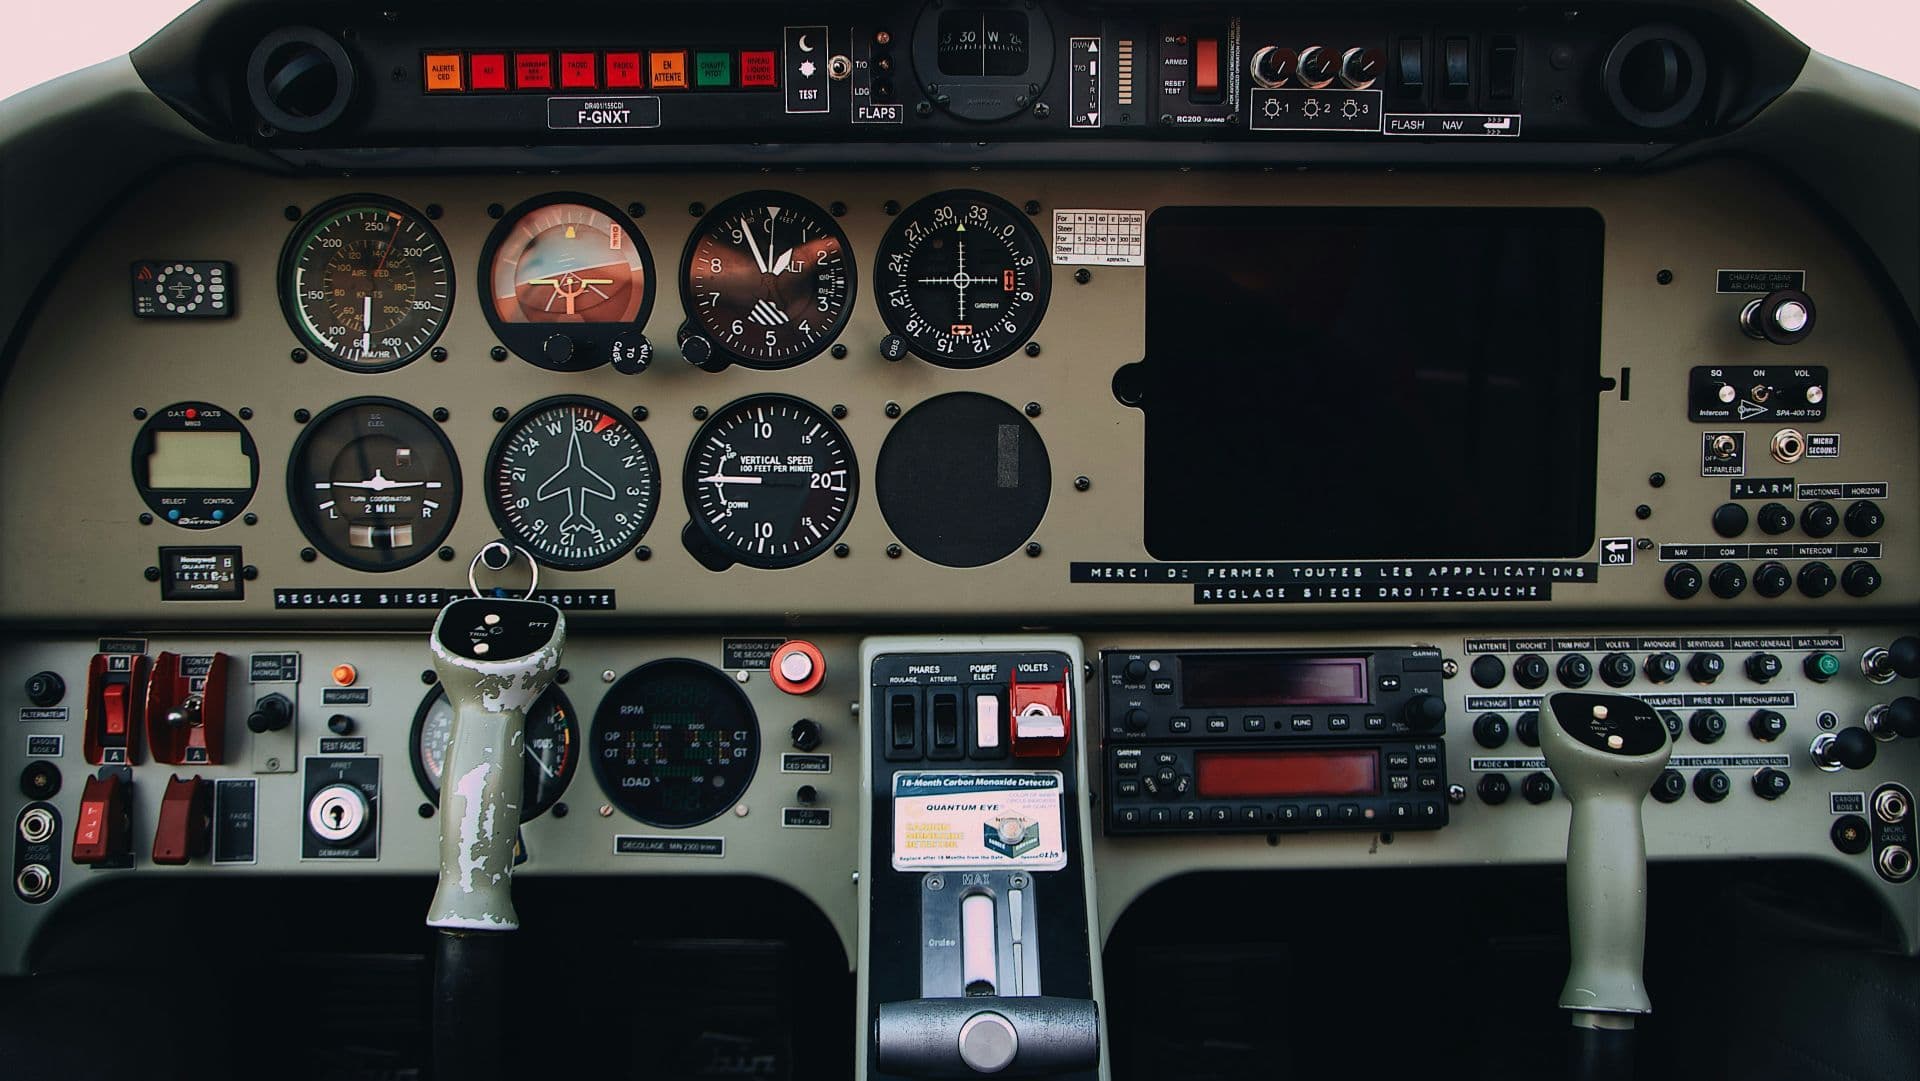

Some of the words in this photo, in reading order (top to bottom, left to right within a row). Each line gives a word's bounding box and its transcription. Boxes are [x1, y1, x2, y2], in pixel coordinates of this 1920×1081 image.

[959, 31, 976, 43] 30
[988, 31, 999, 43] W
[432, 65, 456, 73] ALERTE
[663, 61, 672, 71] EN
[856, 60, 868, 69] T/O
[1074, 64, 1087, 73] T/O
[437, 73, 451, 81] CED
[654, 72, 682, 82] ATTENTE
[1164, 80, 1186, 88] RESET
[799, 90, 818, 100] TEST
[855, 87, 870, 97] LDG
[859, 107, 896, 120] FLAPS
[1324, 104, 1332, 114] 2
[1362, 104, 1370, 114] 3
[578, 111, 631, 125] F-GNXT
[1076, 115, 1087, 123] UP
[1391, 120, 1425, 131] FLASH
[1442, 120, 1464, 131] NAV
[934, 205, 954, 222] 30
[968, 205, 988, 221] 33
[365, 222, 384, 232] 250
[904, 221, 923, 242] 27
[731, 229, 744, 244] 9
[323, 239, 342, 248] 200
[403, 248, 423, 258] 300
[817, 251, 829, 266] 2
[711, 258, 723, 274] 8
[888, 254, 904, 273] 24
[308, 291, 325, 300] 150
[709, 292, 721, 308] 7
[413, 301, 432, 310] 350
[817, 296, 829, 312] 3
[329, 326, 346, 336] 100
[732, 320, 744, 336] 6
[798, 320, 811, 336] 4
[382, 338, 402, 347] 400
[765, 331, 777, 347] 5
[889, 340, 901, 360] OBS
[1710, 369, 1723, 378] SQ
[1753, 369, 1765, 377] ON
[1794, 369, 1810, 377] VOL
[200, 410, 222, 418] VOLTS
[1699, 409, 1730, 417] Intercom
[545, 421, 562, 436] W
[575, 419, 593, 433] 30
[754, 422, 772, 439] 10
[602, 429, 621, 447] 33
[801, 435, 812, 444] 15
[1813, 437, 1834, 445] MICRO
[521, 437, 541, 456] 24
[1808, 446, 1837, 455] SECOURS
[740, 455, 781, 465] VERTICAL
[786, 455, 814, 465] SPEED
[740, 465, 753, 473] 100
[754, 465, 772, 473] FEET
[773, 465, 788, 473] PER
[789, 465, 814, 473] MINUTE
[810, 472, 832, 489] 20
[1801, 488, 1841, 496] DIRECTIONNEL
[1851, 487, 1881, 495] HORIZON
[365, 505, 372, 513] 2
[375, 504, 396, 513] MIN
[728, 501, 749, 509] DOWN
[801, 516, 812, 526] 15
[754, 522, 773, 539] 10
[1719, 548, 1736, 556] COM
[1765, 548, 1779, 556] ATC
[1799, 547, 1833, 555] INTERCOM
[1608, 554, 1625, 563] ON
[1091, 568, 1149, 578] MERCI
[1208, 568, 1275, 578] FERMER
[1292, 567, 1362, 577] TOUTES
[1380, 567, 1413, 577] LES
[1428, 566, 1584, 578] APPPLICATIONS
[1203, 588, 1285, 599] REGLAGE
[1303, 588, 1362, 598] SIEGE
[1379, 586, 1537, 598] DROITE-GAUCHE
[277, 594, 362, 604] REGLAGE
[380, 594, 439, 604] SIEGE
[1515, 642, 1547, 650] CROCHET
[1557, 641, 1574, 649] TRIM
[1605, 640, 1631, 648] VOLETS
[1643, 640, 1677, 648] AVIONIQUE
[1687, 640, 1725, 648] SERVITUDES
[1761, 640, 1792, 648] GENERALE
[1814, 639, 1840, 647] TAMPON
[114, 660, 126, 670] M
[969, 665, 997, 673] POMPE
[1018, 663, 1048, 673] VOLETS
[1664, 660, 1676, 670] 40
[1708, 659, 1720, 670] 40
[909, 665, 941, 674] PHARES
[890, 676, 917, 684] ROULAGE
[974, 673, 994, 681] ELECT
[33, 682, 40, 691] 5
[1155, 682, 1170, 690] MON
[1471, 699, 1507, 707] AFFICHAGE
[1739, 696, 1787, 704] PRECHAUFFAGE
[620, 705, 644, 715] RPM
[1293, 719, 1312, 727] FUNC
[1369, 718, 1383, 726] ENT
[1822, 714, 1833, 728] 3
[604, 732, 621, 741] OP
[111, 752, 119, 761] A
[1117, 749, 1142, 757] GARMIN
[1160, 754, 1172, 762] ON
[1390, 757, 1408, 765] FUNC
[1478, 760, 1501, 768] FADEC
[1502, 760, 1509, 768] A
[1522, 760, 1546, 768] FADEC
[622, 777, 651, 788] LOAD
[902, 778, 942, 788] 18-Month
[943, 777, 975, 787] Carbon
[976, 777, 1017, 788] Monoxide
[1018, 777, 1055, 788] Detector
[962, 873, 990, 886] MAX
[928, 938, 956, 947] Cruise
